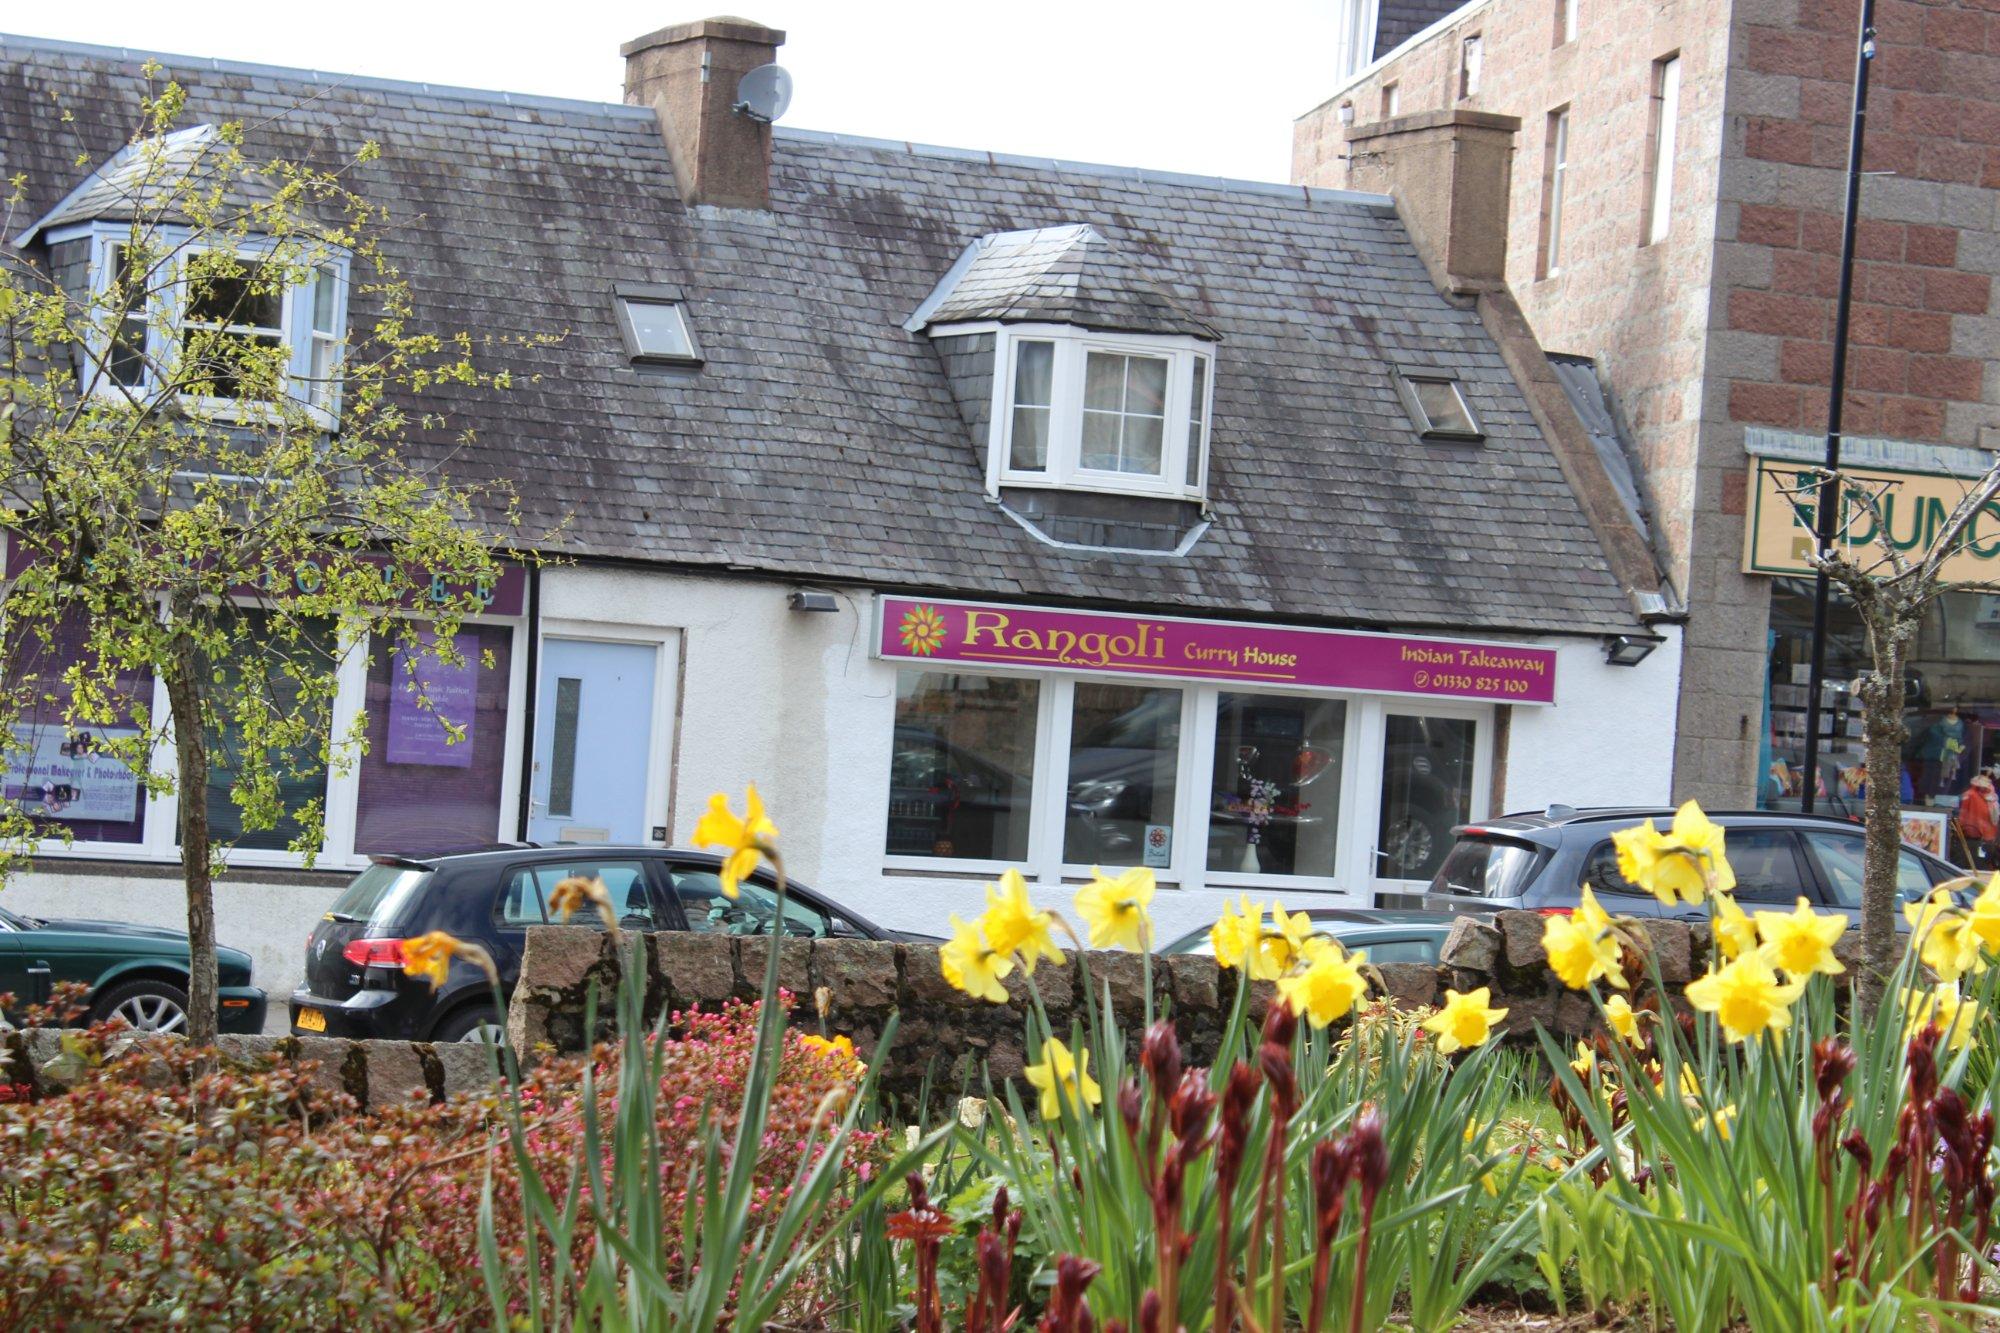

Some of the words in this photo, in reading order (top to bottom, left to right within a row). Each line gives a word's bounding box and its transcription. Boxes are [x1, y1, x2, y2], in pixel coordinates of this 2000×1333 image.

[961, 610, 1167, 666] Rangoli
[1184, 642, 1238, 666] Curry
[1244, 647, 1297, 667] House
[1401, 645, 1454, 664] Indian
[1459, 650, 1545, 676] Takeaway
[1433, 674, 1472, 689] 01330
[1475, 677, 1500, 692] 825
[1504, 679, 1528, 693] 100
